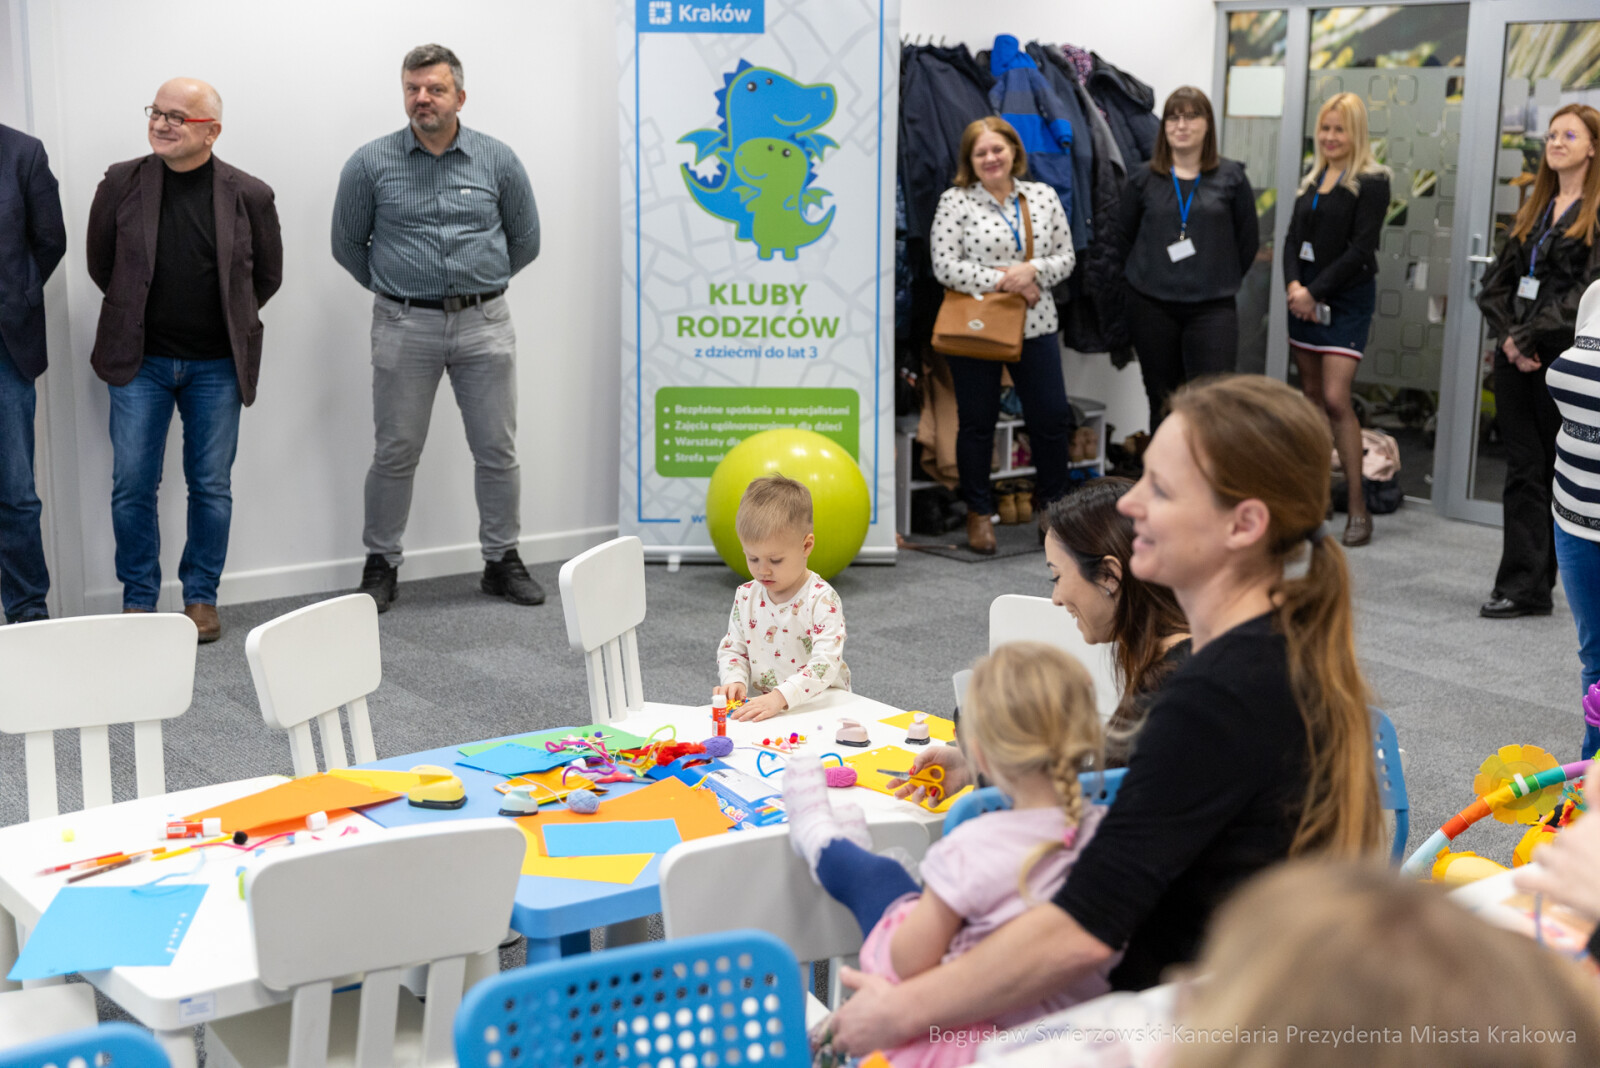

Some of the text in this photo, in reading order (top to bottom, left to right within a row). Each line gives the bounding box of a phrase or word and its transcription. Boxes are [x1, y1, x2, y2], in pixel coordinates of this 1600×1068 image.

[679, 3, 752, 23] Kraków
[709, 283, 808, 306] KLUBY
[677, 308, 840, 338] RODZICÓW
[695, 346, 819, 359] z dziećmi do lat 3
[675, 404, 850, 417] Bezpłatne spotkania ze specjalistami
[797, 421, 813, 431] dla
[814, 421, 843, 432] dzieci
[675, 436, 725, 448] Warsztaty
[675, 453, 704, 463] Strefa
